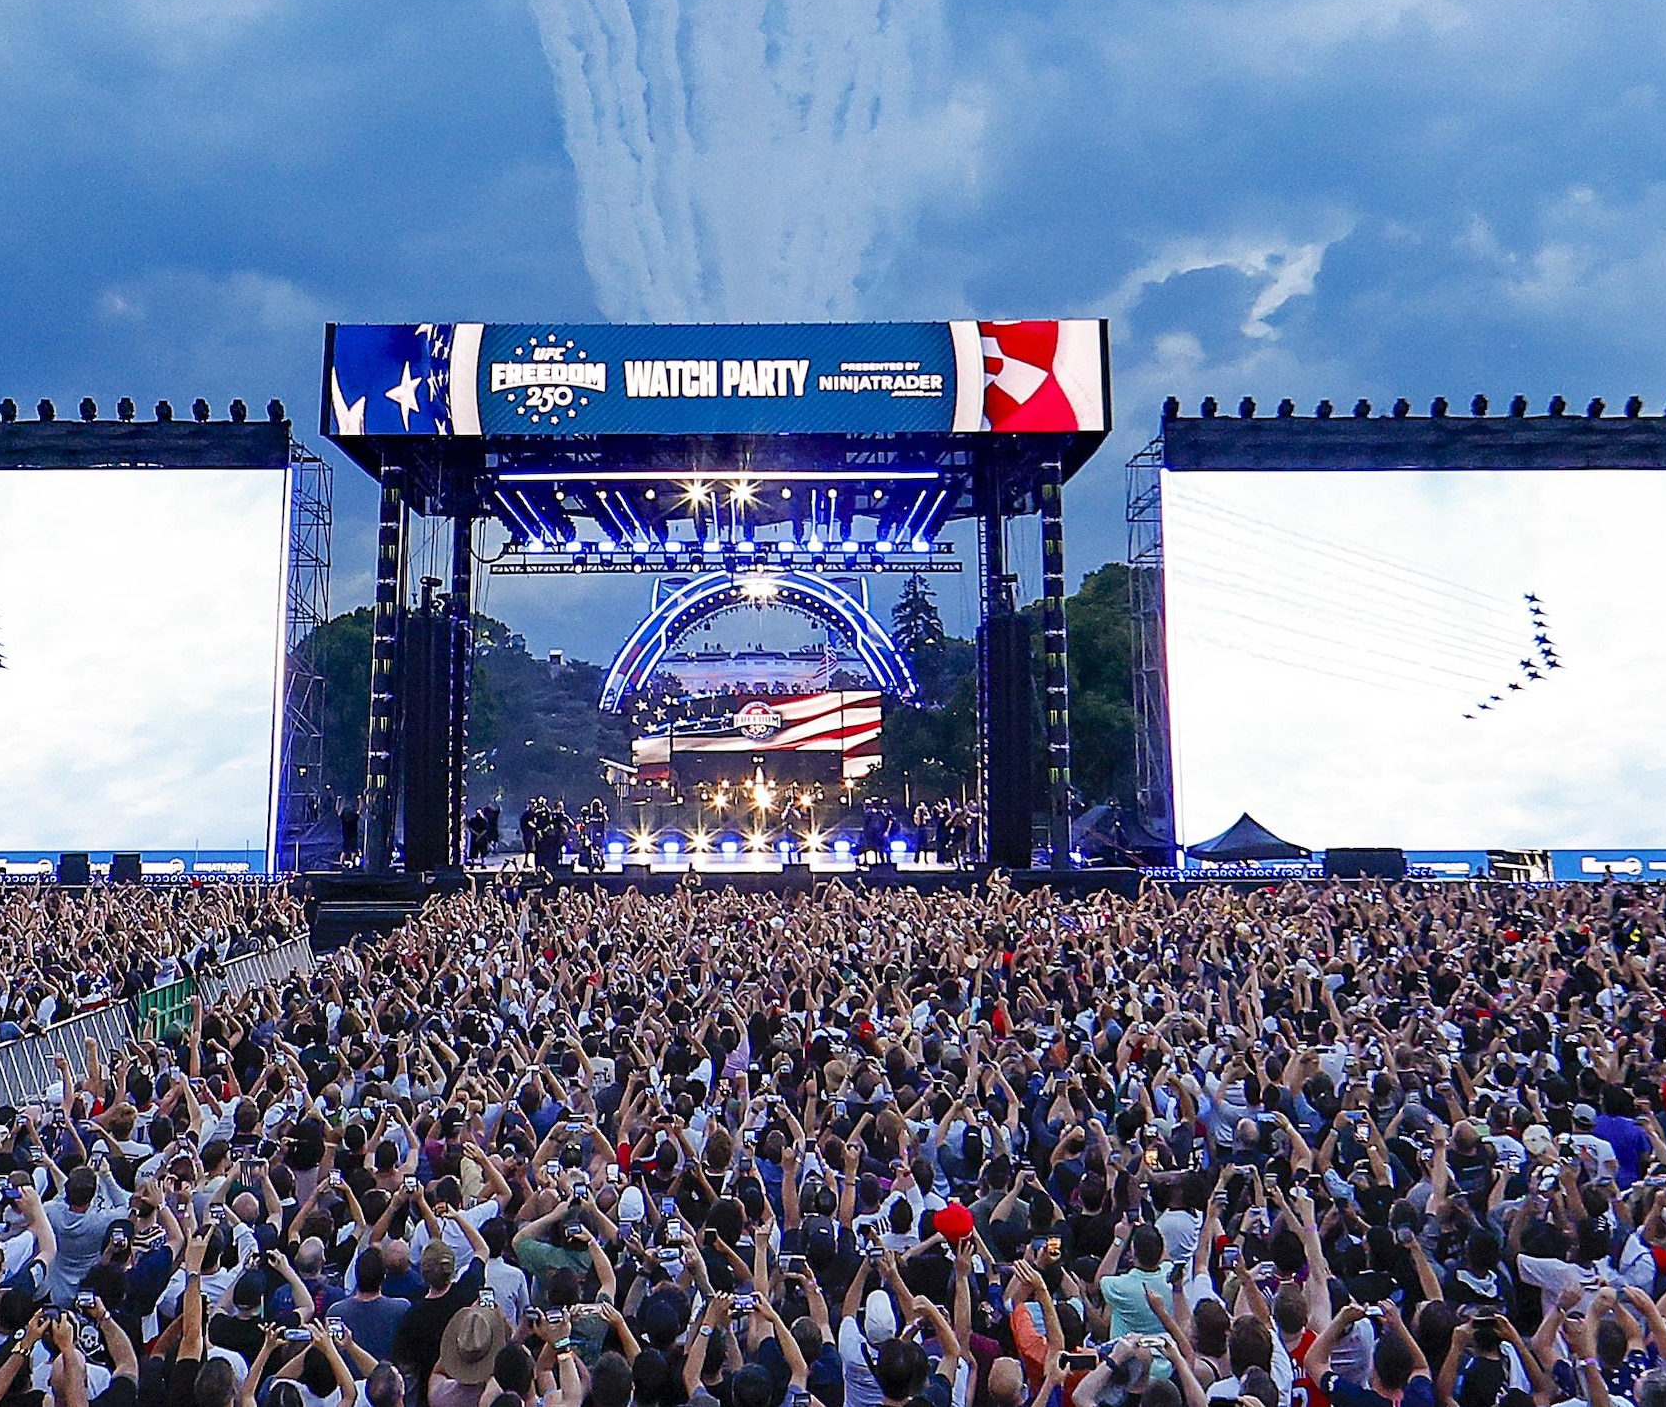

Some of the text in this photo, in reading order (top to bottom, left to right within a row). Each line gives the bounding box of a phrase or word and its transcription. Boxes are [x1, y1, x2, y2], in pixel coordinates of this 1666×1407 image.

[532, 347, 566, 361] UFC
[491, 362, 606, 393] FREEDOM
[905, 362, 921, 371] BY
[624, 359, 810, 397] WATCH PARTY
[819, 375, 943, 393] NINJATRADER
[525, 386, 573, 413] 250
